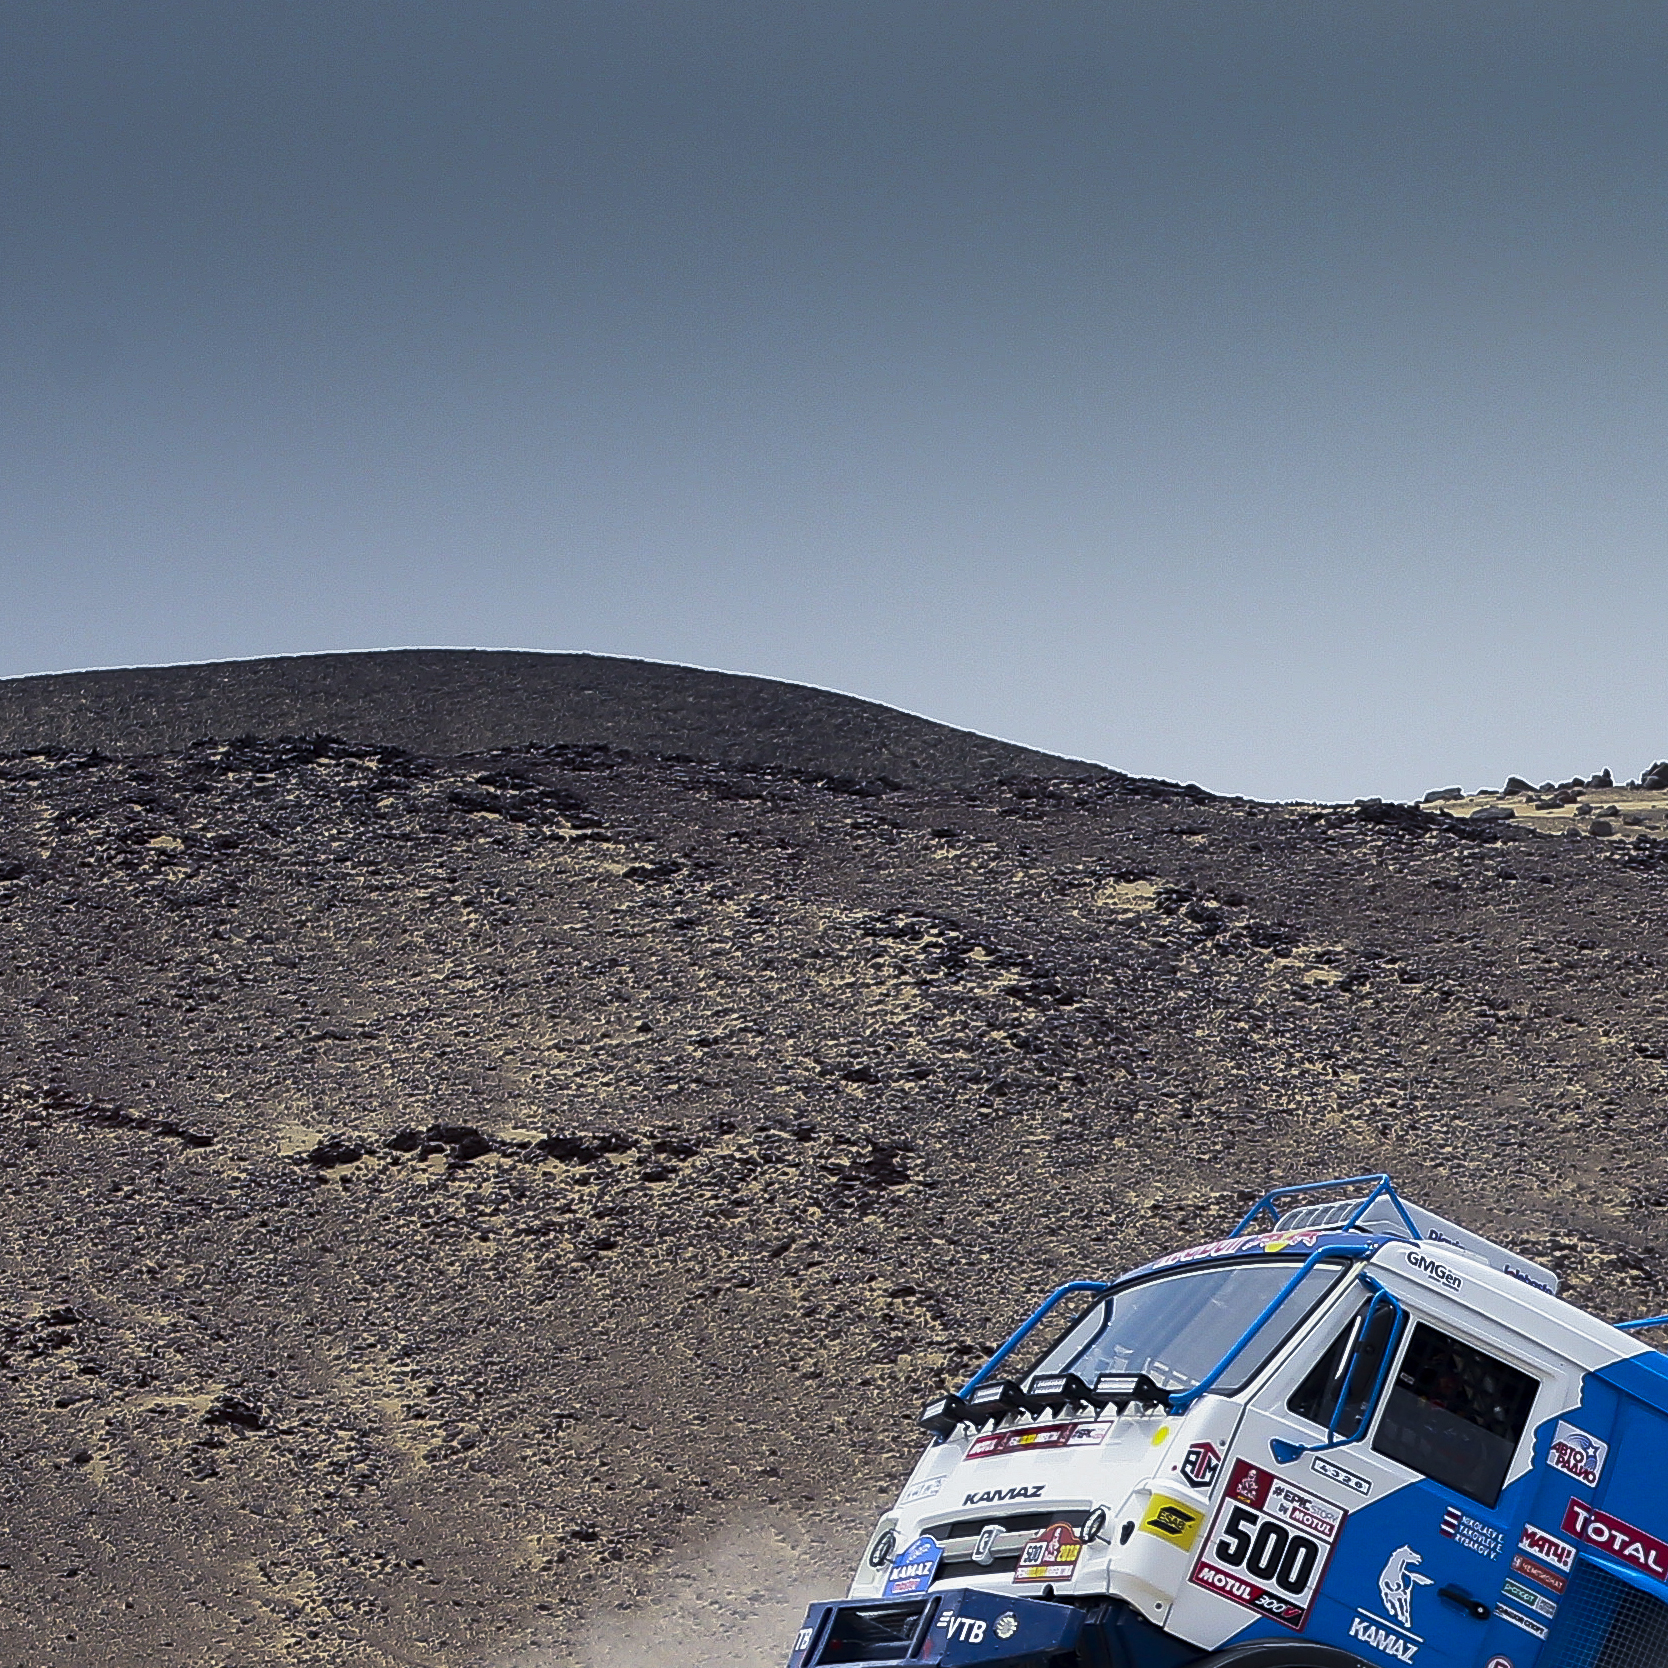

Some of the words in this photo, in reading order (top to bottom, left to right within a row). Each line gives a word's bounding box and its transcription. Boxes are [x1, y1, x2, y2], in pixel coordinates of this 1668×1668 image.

[1407, 1252, 1462, 1288] GMGen
[962, 1485, 1046, 1505] KAMAZ
[1292, 1510, 1333, 1535] MOTUL
[1574, 1506, 1663, 1573] TOTAL
[1215, 1504, 1319, 1595] 500
[1198, 1567, 1252, 1599] MOTUL
[1255, 1593, 1303, 1618] 300V
[947, 1616, 987, 1644] VTB
[1349, 1618, 1418, 1664] KAMAZ
